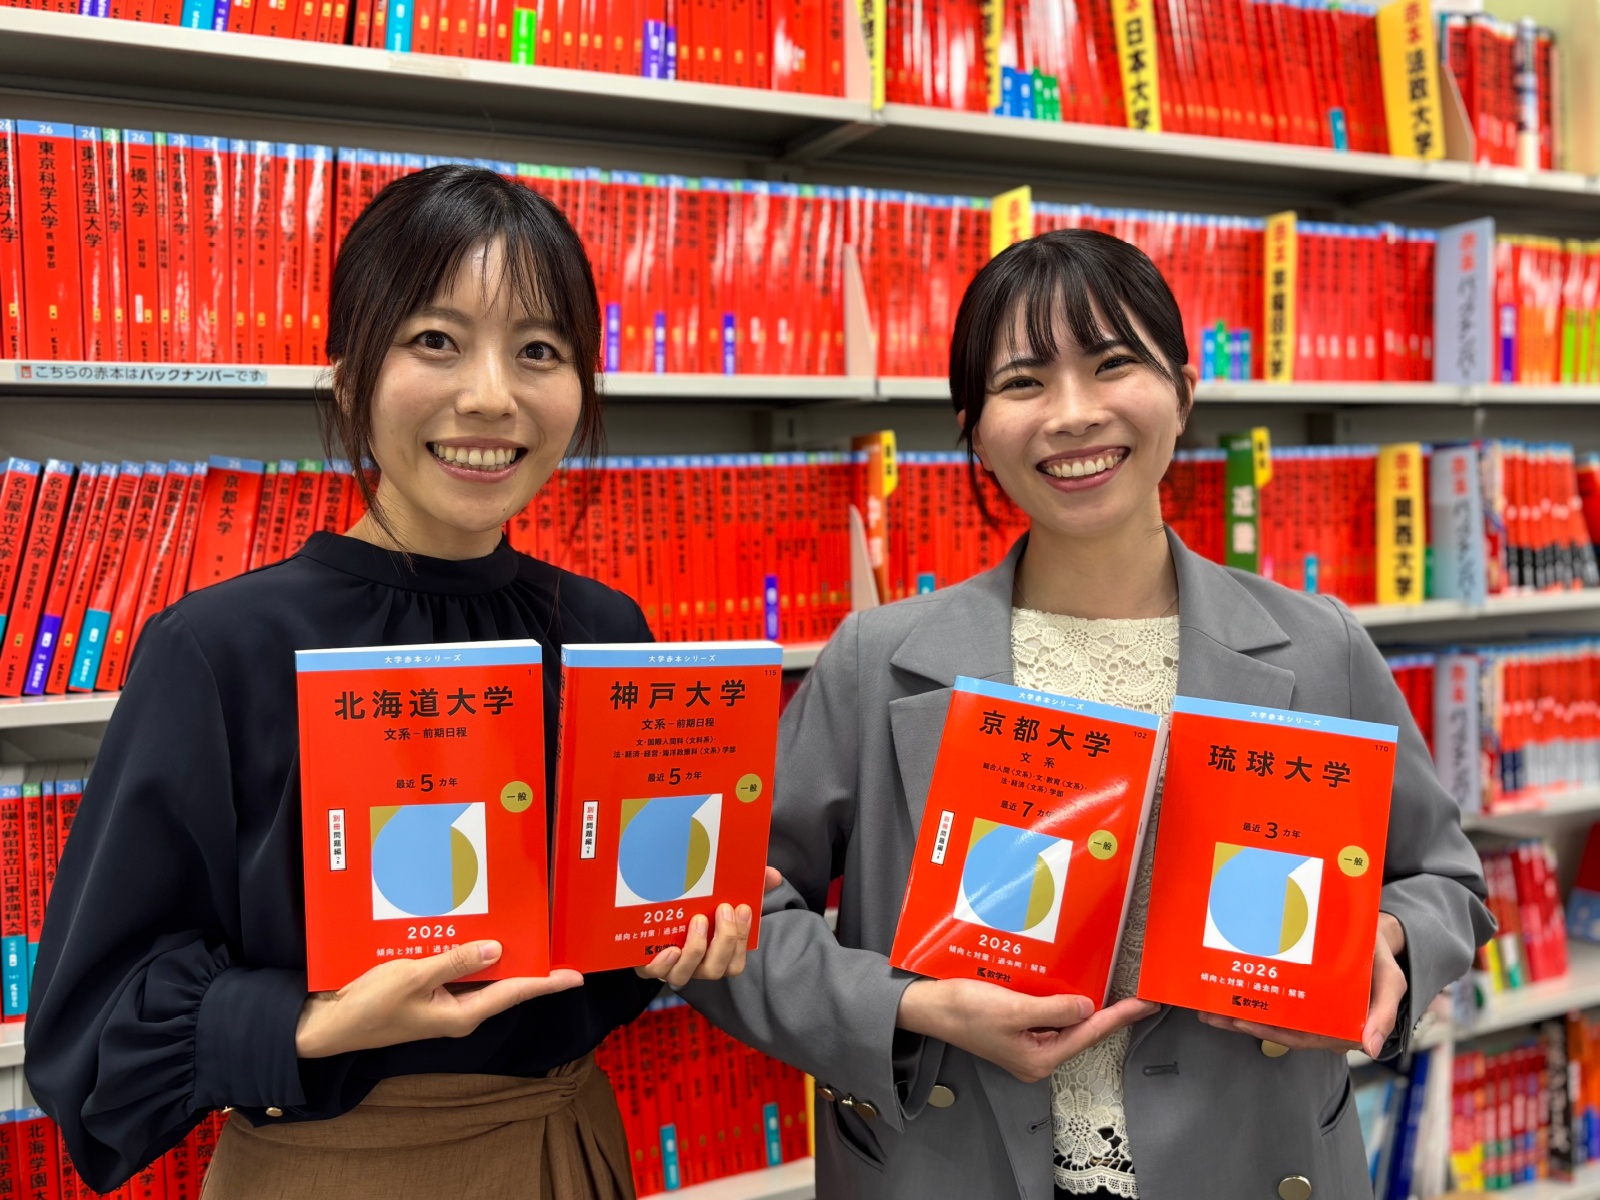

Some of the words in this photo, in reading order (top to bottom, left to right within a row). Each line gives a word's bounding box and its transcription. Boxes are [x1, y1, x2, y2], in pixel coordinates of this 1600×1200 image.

[1126, 17, 1150, 131] 日本大学
[1406, 49, 1432, 156] 法政大学
[39, 124, 53, 134] 26
[132, 133, 145, 142] 26
[38, 141, 58, 229] 東京科学大学
[130, 154, 149, 217] 一橋大学
[173, 153, 188, 235] 東京都立大学
[81, 146, 102, 248] 東京学芸大学
[204, 155, 219, 237] 東京都立大学
[36, 365, 260, 382] こちらの赤本はバックナンバーです
[16, 461, 31, 471] 26
[126, 464, 140, 474] 26
[150, 464, 163, 473] 26
[174, 463, 189, 473] 26
[87, 480, 111, 543] 三重大学
[109, 480, 137, 543] 三重大学
[132, 480, 160, 543] 滋賀大学
[216, 474, 241, 536] 京都大学
[31, 477, 63, 559] 名古屋市立大学
[1395, 498, 1413, 599] 関西大学
[384, 653, 462, 664] 大学赤本シリーズ
[648, 654, 717, 664] 大学赤本シリーズ
[764, 669, 777, 677] 115
[334, 685, 514, 720] 北海道大学
[609, 679, 746, 710] 神戸大学
[1018, 691, 1085, 711] 大学赤本シリーズ
[1250, 710, 1321, 727] 大学赤本シリーズ
[978, 709, 1112, 758] 京都大学
[1133, 730, 1148, 740] 102
[1374, 744, 1389, 752] 170
[1019, 751, 1056, 770] 文系
[1207, 744, 1351, 789] 琉球大学
[395, 779, 416, 789] 最近
[420, 773, 434, 793] 5
[647, 772, 665, 783] 最近
[668, 767, 682, 786] 5
[3, 788, 17, 797] 26
[26, 786, 40, 796] 25
[62, 782, 77, 792] 26
[740, 783, 758, 793] 一般
[506, 791, 528, 803] 一般
[1000, 799, 1018, 812] 最近
[1021, 800, 1035, 818] 7
[1242, 821, 1261, 834] 最近
[1264, 821, 1279, 840] 3
[1092, 840, 1113, 852] 一般
[1343, 856, 1364, 868] 一般
[643, 907, 685, 924] 2026
[407, 924, 456, 940] 2026
[614, 929, 656, 942] 傾向と対策
[663, 925, 687, 936] 過去問
[376, 945, 423, 957] 傾向と対策
[977, 934, 1023, 956] 2026
[948, 943, 990, 962] 傾向と対策
[997, 956, 1023, 969] 過去問
[1029, 963, 1048, 975] 解答
[986, 968, 1012, 984] 教学社
[1231, 960, 1278, 979] 2026
[1200, 972, 1244, 988] 傾向と対策
[1252, 982, 1280, 994] 過去問
[1287, 988, 1306, 999] 解答
[1242, 997, 1269, 1011] 教学社
[28, 1107, 41, 1118] 26
